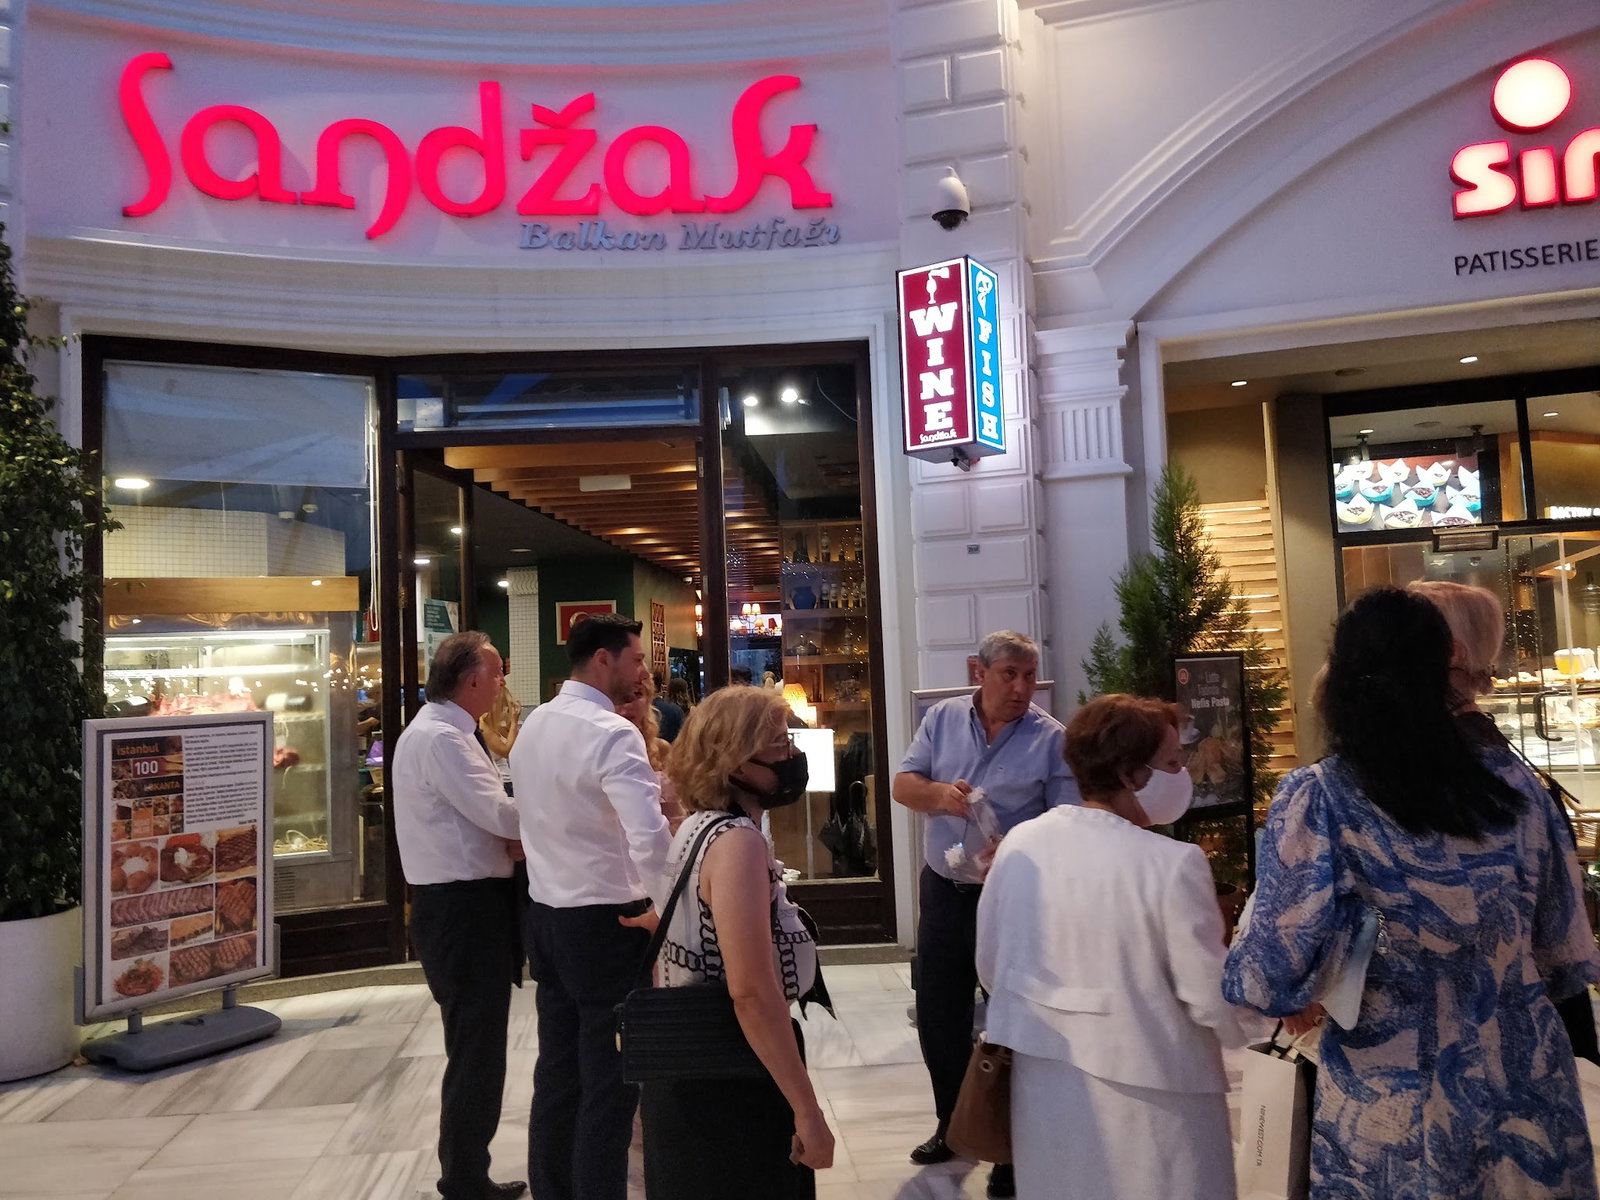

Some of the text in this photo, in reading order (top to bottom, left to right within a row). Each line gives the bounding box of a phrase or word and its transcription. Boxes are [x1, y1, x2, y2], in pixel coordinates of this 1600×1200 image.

[120, 51, 834, 240] Sandžak
[519, 217, 841, 251] Balkan Mutfağı
[1454, 239, 1599, 276] PATISSERIE
[909, 301, 958, 432] WINE
[977, 316, 1000, 440] FISH
[134, 760, 159, 776] 100
